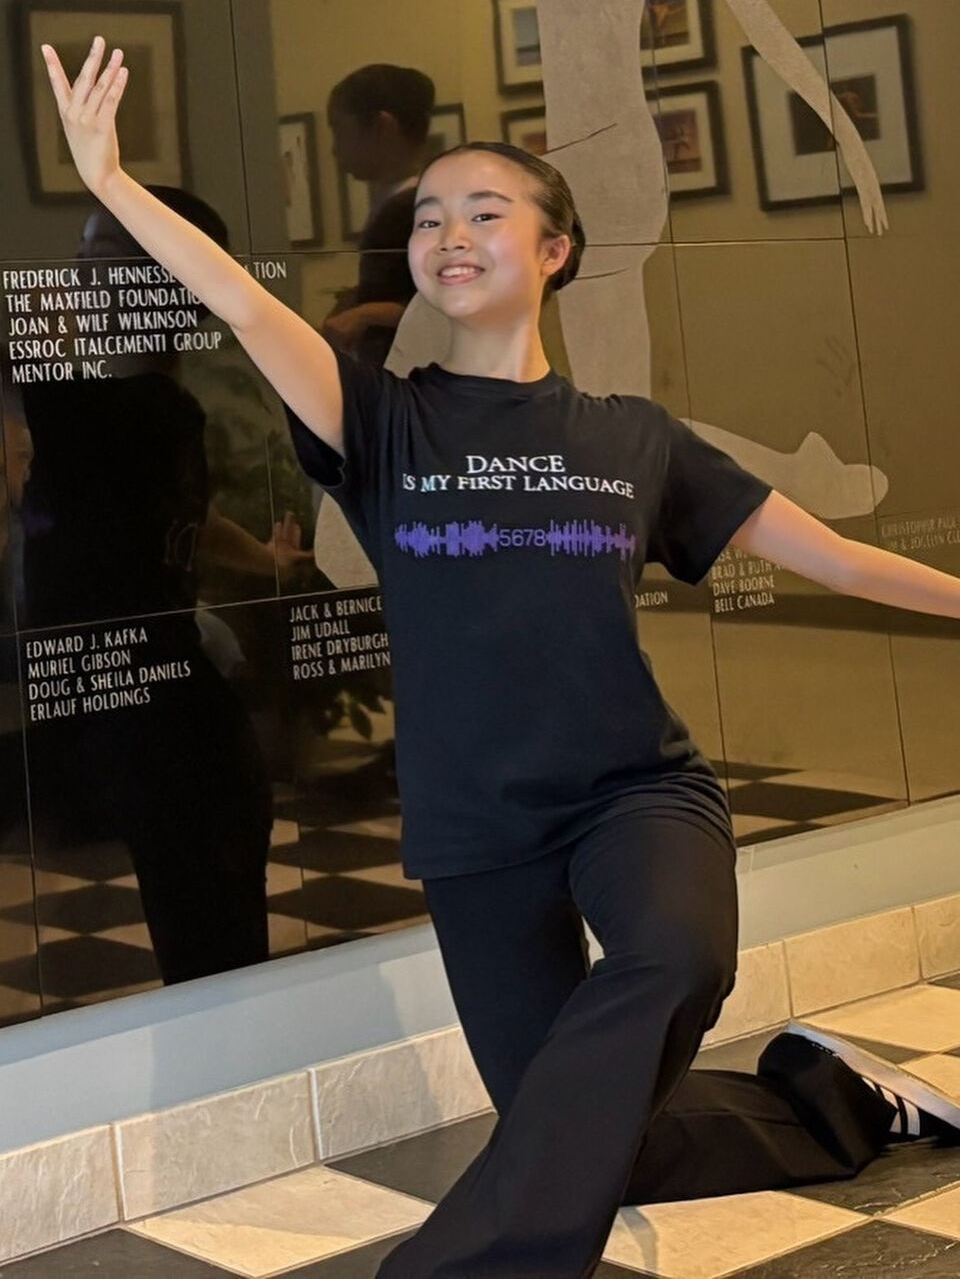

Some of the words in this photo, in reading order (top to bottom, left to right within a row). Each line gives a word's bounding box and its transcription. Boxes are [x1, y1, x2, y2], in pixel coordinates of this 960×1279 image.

[9, 316, 50, 336] JOAN
[58, 316, 67, 333] &
[76, 314, 109, 333] WILF
[118, 310, 197, 331] WILKINSON
[9, 339, 66, 360] ESSROC
[75, 334, 166, 356] ITALCEMENTI
[174, 332, 221, 351] GROUP
[12, 362, 74, 383] MENTOR
[82, 361, 112, 380] INC.
[466, 456, 566, 473] DANCE
[421, 475, 451, 492] MY
[457, 476, 516, 490] FIRST
[524, 476, 635, 498] LANGUAGE
[499, 529, 546, 546] 5678
[714, 597, 734, 613] BELL
[737, 593, 775, 610] CANADA
[291, 624, 310, 642] JIM
[315, 619, 350, 639] UDALL
[26, 635, 83, 659] EDWARD
[90, 633, 99, 650] J.
[105, 628, 148, 648] KAFKA
[291, 642, 321, 661] IRENE
[326, 633, 388, 656] DRYBURGH
[28, 657, 75, 679] MURIEL
[82, 650, 131, 672] GIBSON
[29, 678, 70, 700] DOUG
[76, 676, 85, 693] &
[91, 669, 134, 691] SHEILA
[140, 661, 191, 684] DANIELS
